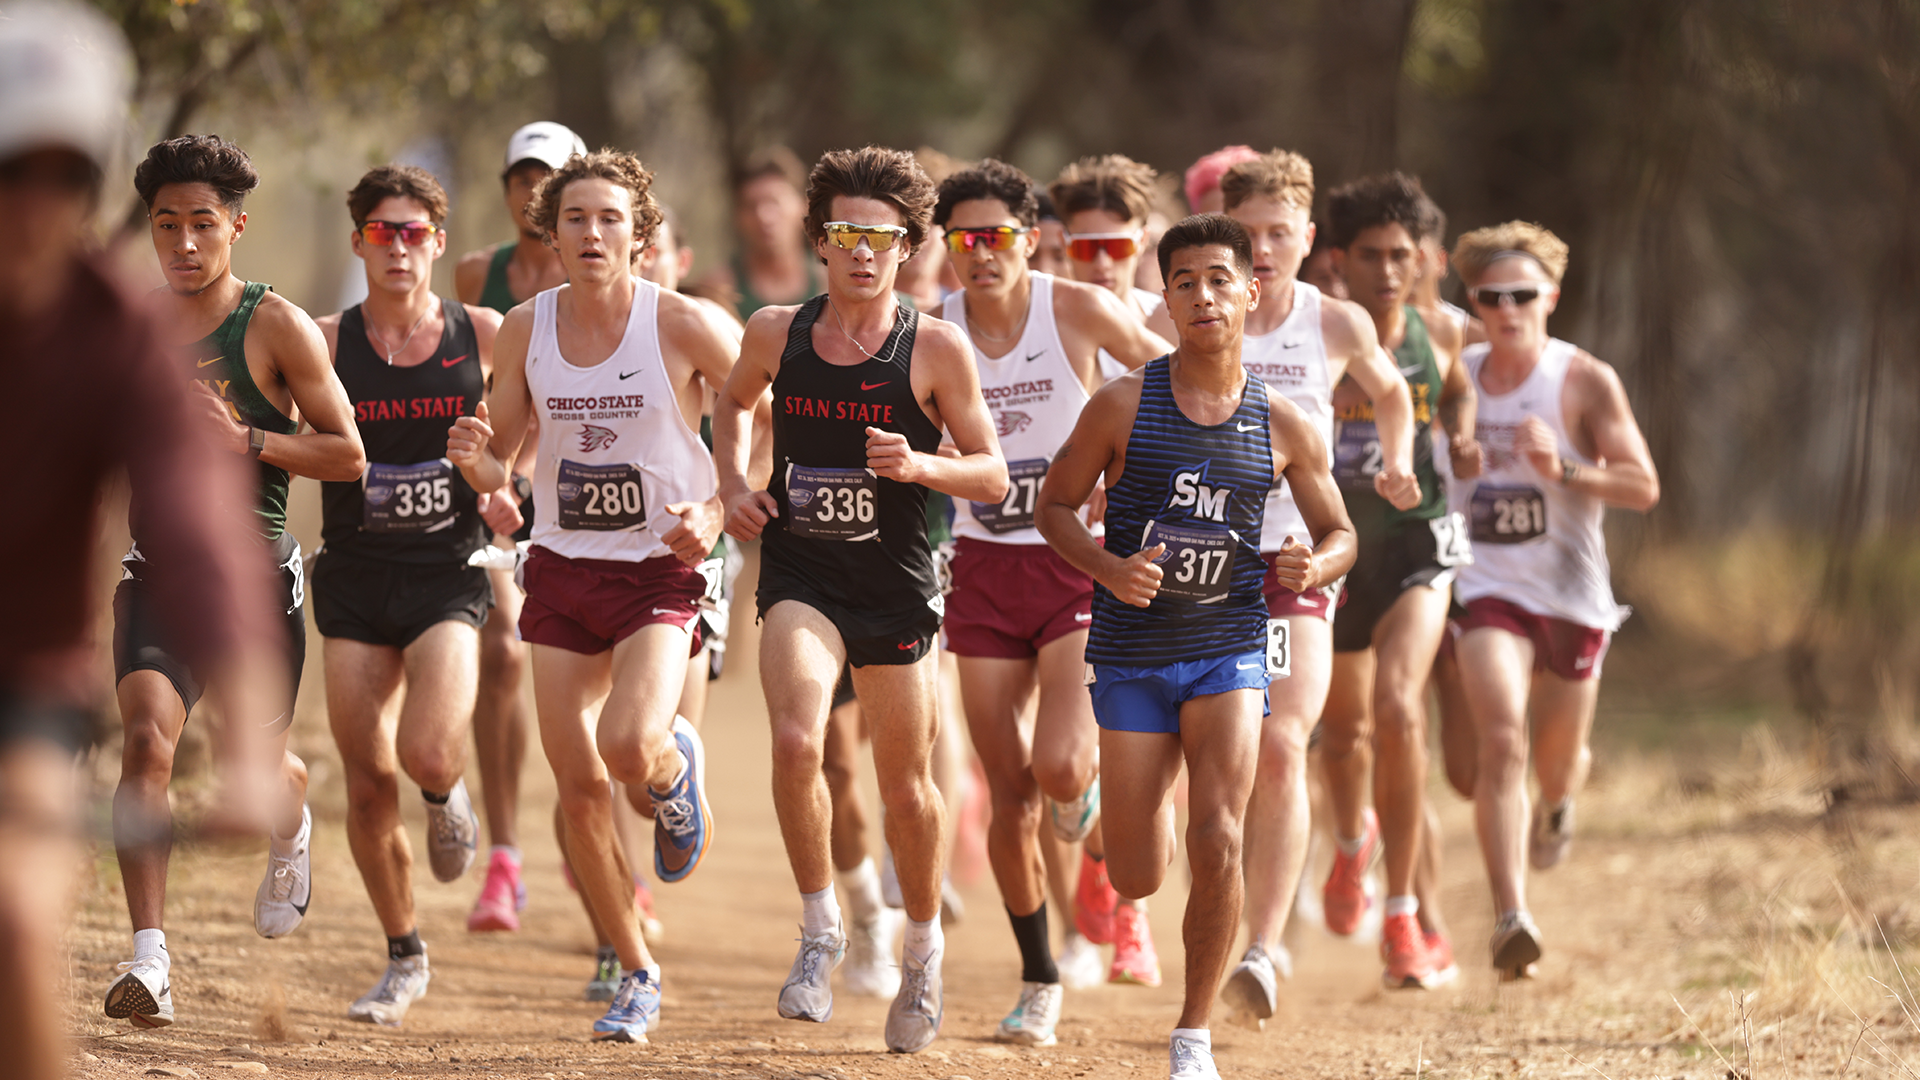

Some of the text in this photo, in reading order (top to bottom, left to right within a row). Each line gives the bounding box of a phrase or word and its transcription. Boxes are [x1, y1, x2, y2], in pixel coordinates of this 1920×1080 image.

[546, 395, 644, 410] CHICO STATE
[1012, 379, 1054, 396] STATE
[356, 395, 465, 422] STAN STATE
[551, 410, 640, 421] CROSS COUNTRY
[785, 396, 893, 424] STAN STATE
[394, 477, 451, 517] 335
[582, 481, 642, 516] 280
[816, 486, 874, 523] 336
[1168, 472, 1231, 522] SM
[1493, 498, 1543, 534] 281
[1175, 547, 1229, 585] 317
[1272, 625, 1286, 668] 3
